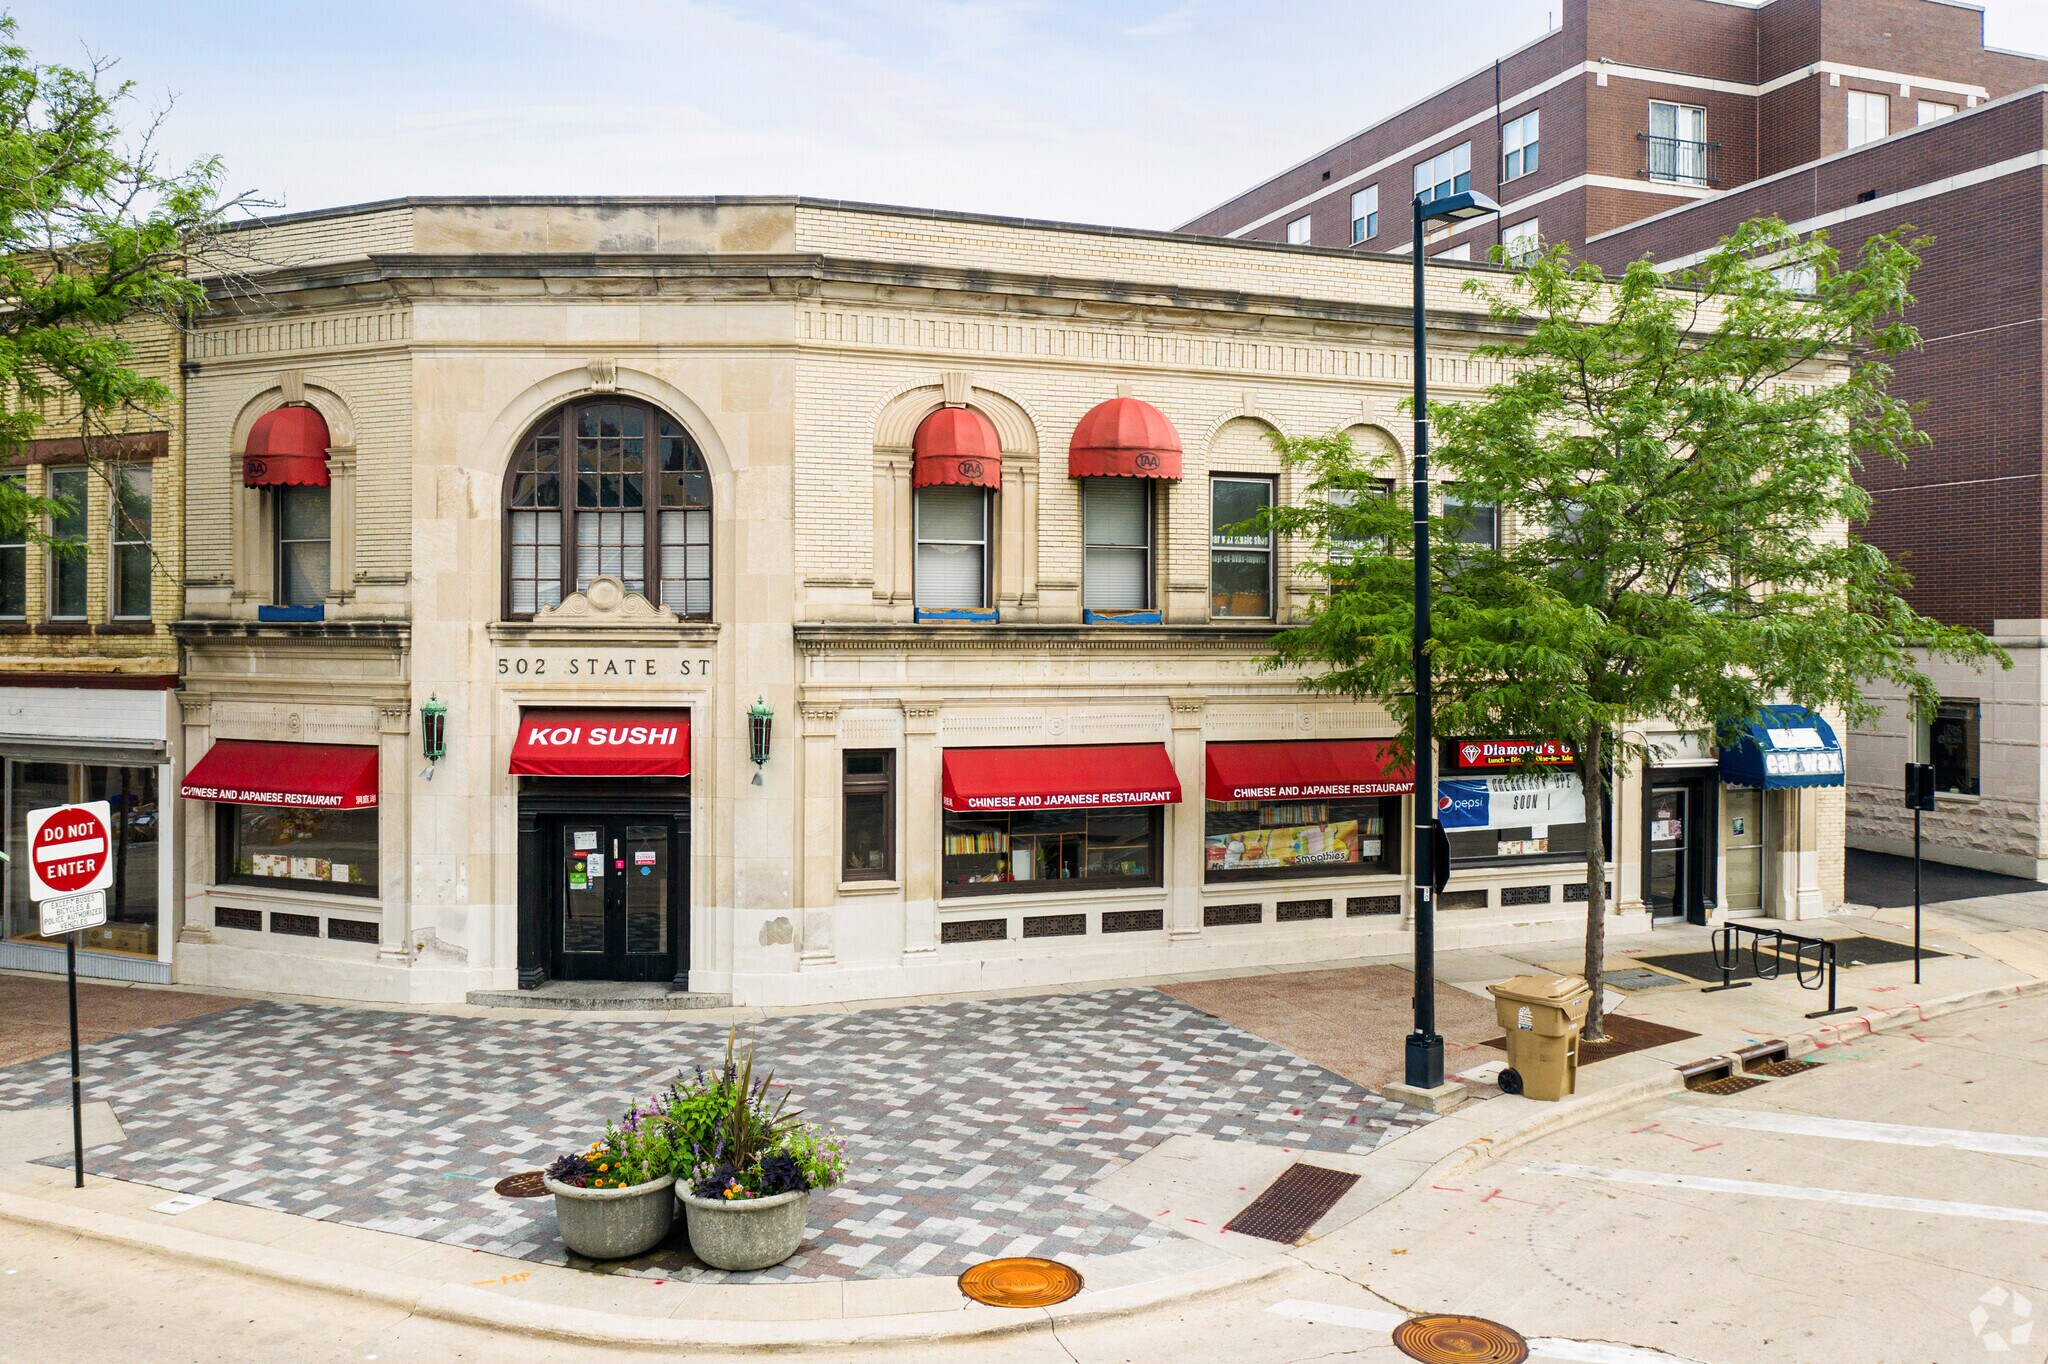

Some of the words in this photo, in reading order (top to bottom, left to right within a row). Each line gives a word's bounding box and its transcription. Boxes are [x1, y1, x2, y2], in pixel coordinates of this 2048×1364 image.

[248, 462, 264, 474] TAA
[962, 463, 983, 475] TAA
[1138, 455, 1160, 467] TAA
[498, 658, 546, 675] 502
[569, 658, 657, 675] STATE
[680, 659, 711, 676] ST
[527, 727, 580, 746] KOI
[587, 726, 678, 746] SUSHI
[1766, 753, 1797, 774] ear
[1800, 752, 1841, 773] wax
[181, 786, 218, 798] CHINESE
[219, 789, 238, 800] AND
[239, 790, 284, 804] JAPANESE
[284, 793, 343, 806] RESTAURANT
[1233, 786, 1277, 798] CHINESE
[1278, 785, 1300, 796] AND
[1301, 784, 1352, 796] JAPANESE
[1353, 782, 1415, 795] RESTAURANT
[968, 796, 1016, 808] CHINESE
[1018, 795, 1042, 807] AND
[1044, 793, 1100, 806] JAPANESE
[1102, 791, 1171, 803] RESTAURANT
[1454, 797, 1483, 810] pepsi
[1513, 793, 1538, 810] SOON
[44, 827, 64, 842] DO
[68, 821, 95, 838] NOT
[1295, 852, 1347, 863] Smoothies
[47, 859, 96, 879] ENTER
[50, 898, 74, 909] EXCEPT
[75, 894, 95, 905] BUSES
[56, 903, 84, 916] BICYCLES
[44, 915, 65, 926] POLICE
[67, 908, 103, 921] AUTHORIZED
[60, 918, 89, 930] VEHICLES
